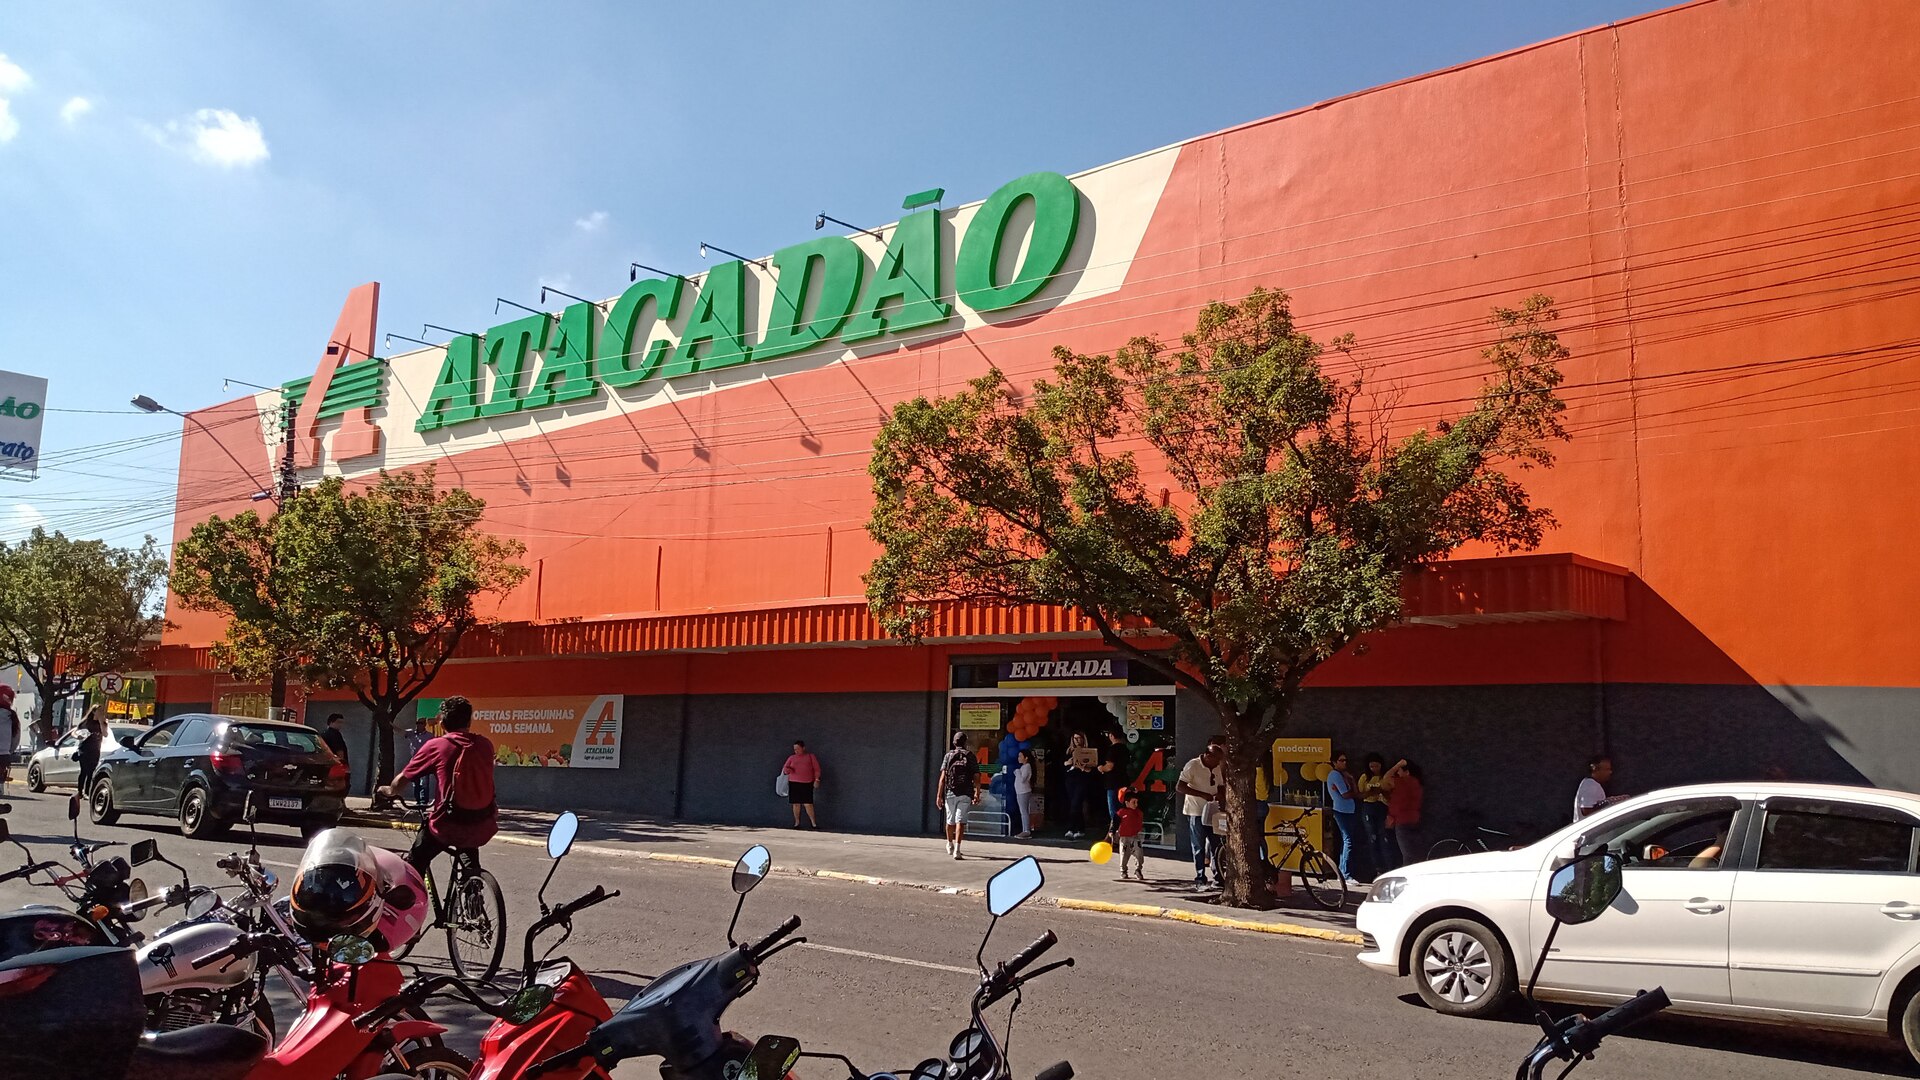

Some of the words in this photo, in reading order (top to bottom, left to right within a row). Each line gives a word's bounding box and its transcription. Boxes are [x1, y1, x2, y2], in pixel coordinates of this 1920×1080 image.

[414, 169, 1081, 434] ATACADÃO
[1009, 659, 1112, 679] ENTRADA
[472, 710, 511, 721] OFERTAS
[512, 709, 575, 720] FRESQUINHAS
[489, 723, 513, 734] TODA
[514, 722, 554, 734] SEMANA.
[1277, 745, 1324, 753] modazine
